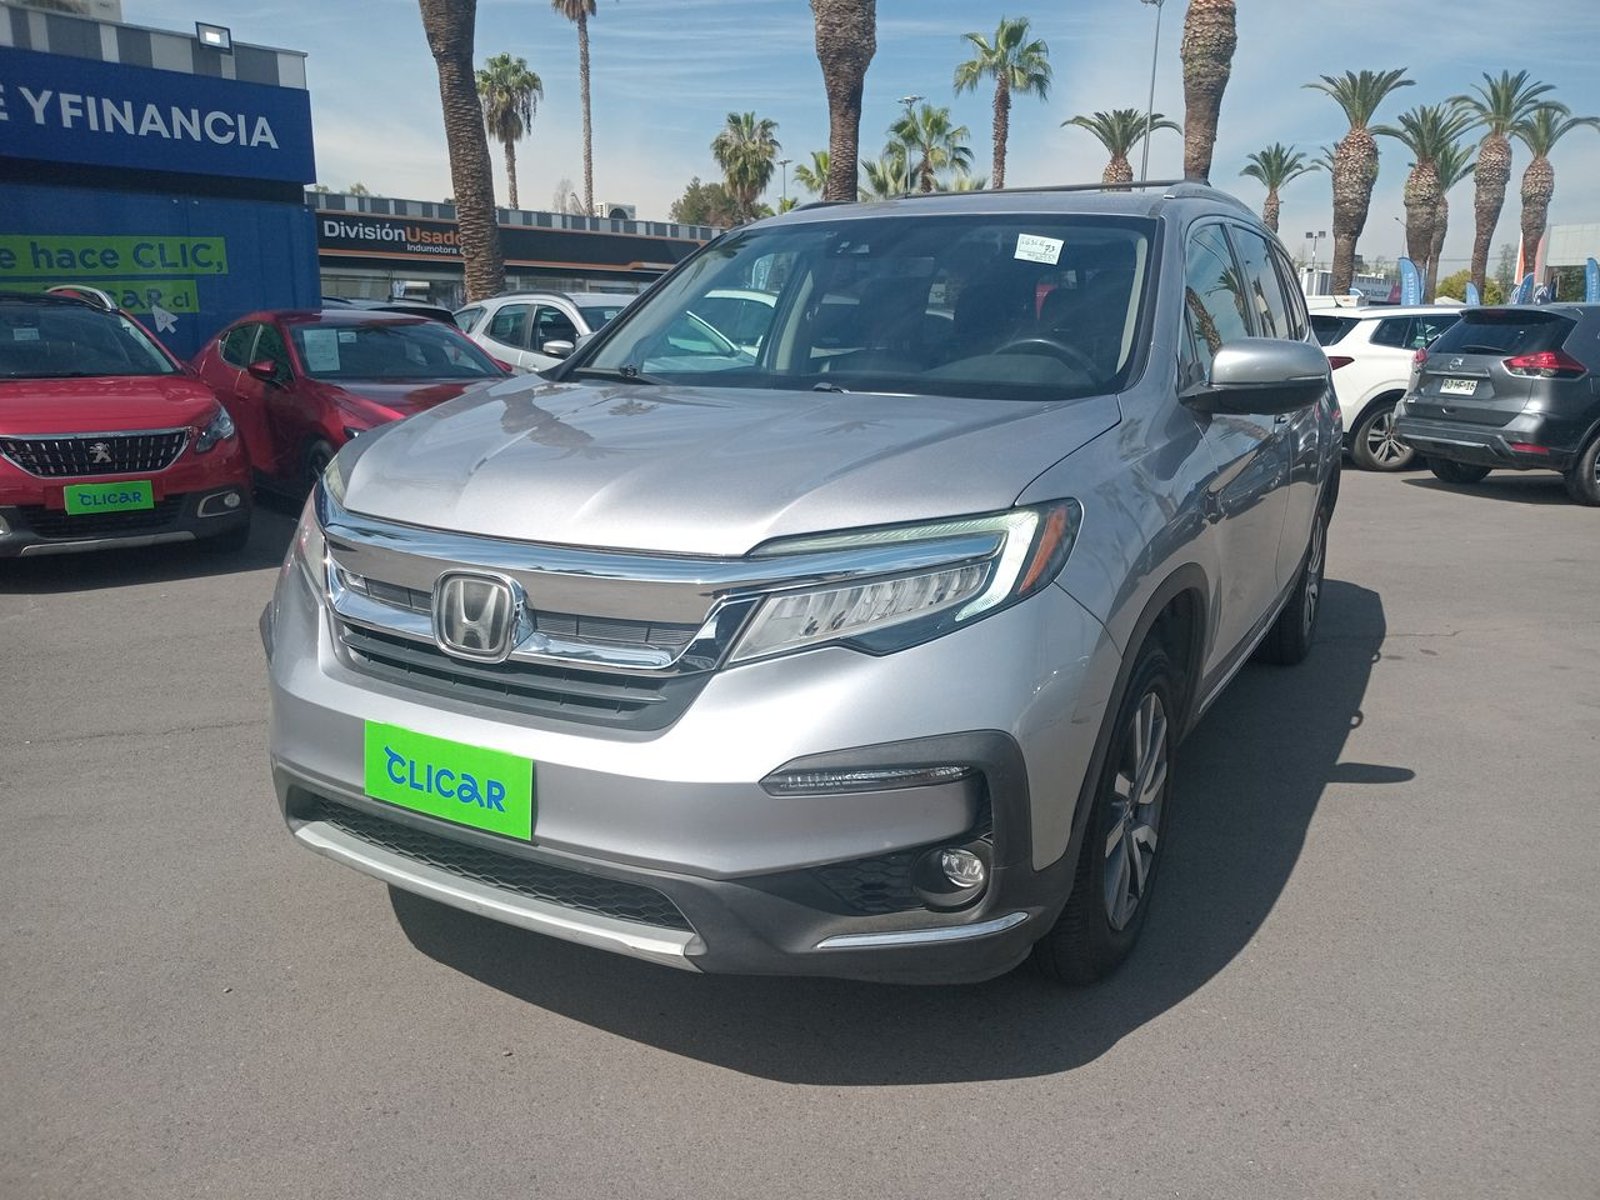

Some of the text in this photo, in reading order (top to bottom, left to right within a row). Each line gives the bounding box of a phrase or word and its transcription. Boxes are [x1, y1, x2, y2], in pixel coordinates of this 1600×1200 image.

[30, 241, 120, 269] hace
[133, 242, 224, 273] CLIC,
[407, 244, 457, 255] Indumotora
